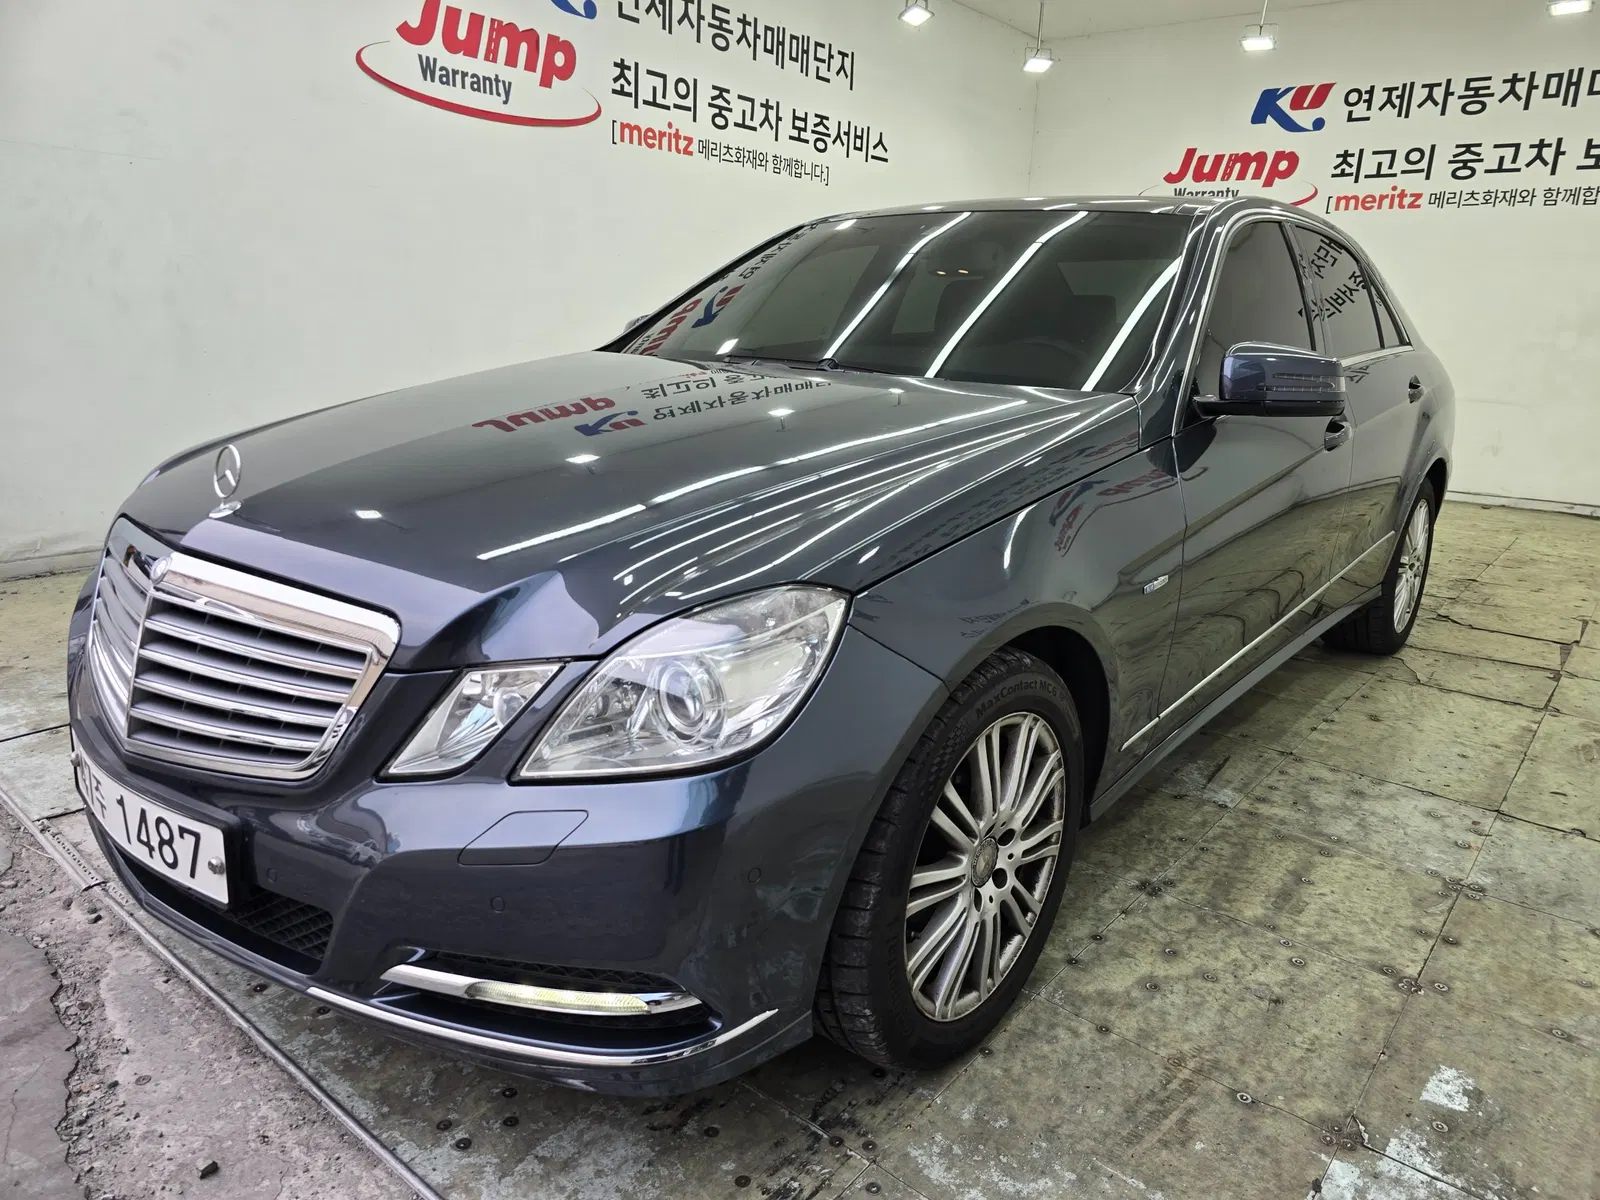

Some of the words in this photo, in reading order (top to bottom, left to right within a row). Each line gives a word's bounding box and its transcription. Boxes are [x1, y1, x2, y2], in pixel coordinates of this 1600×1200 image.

[395, 0, 577, 90] Jump
[416, 53, 512, 106] Warranty
[611, 57, 698, 123] 최고의
[707, 84, 783, 142] 중고차
[788, 108, 889, 163] 보증서비스
[697, 138, 769, 172] 메리츠화재와
[1163, 147, 1300, 188] Jump
[1330, 143, 1437, 184] 최고의
[1447, 136, 1567, 181] 중고차
[1428, 187, 1537, 209] 메리츠화재와
[115, 792, 202, 879] 1487
